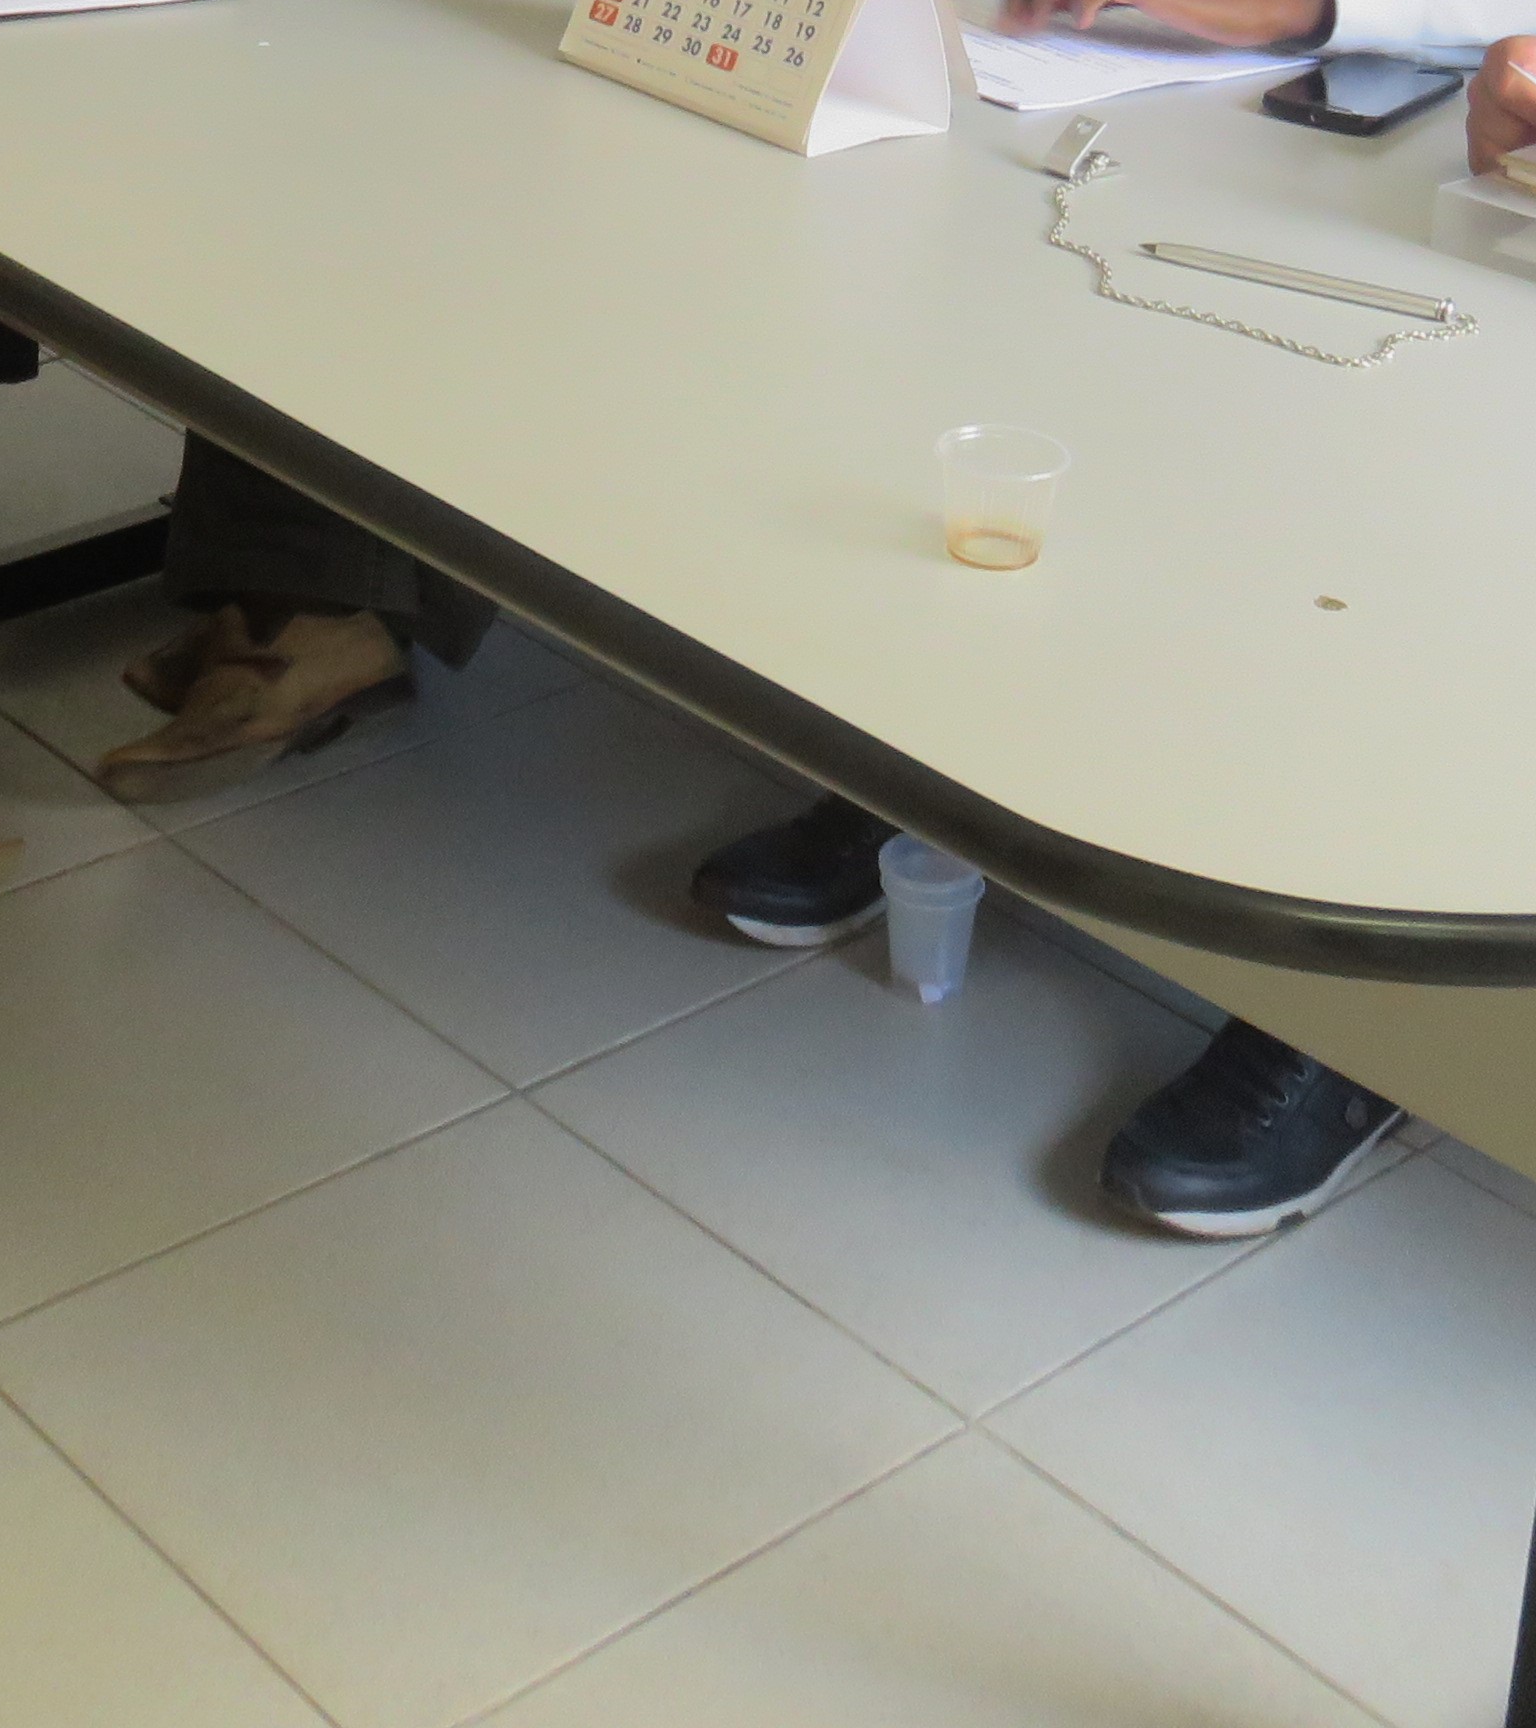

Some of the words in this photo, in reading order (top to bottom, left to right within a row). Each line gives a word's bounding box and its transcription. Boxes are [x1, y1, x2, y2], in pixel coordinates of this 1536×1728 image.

[594, 3, 616, 20] 27
[623, 14, 642, 33] 28
[652, 25, 673, 44] 29
[681, 37, 702, 56] 30
[712, 47, 732, 68] 31
[661, 1, 681, 21] 22
[691, 13, 711, 32] 23
[722, 23, 741, 43] 24
[752, 35, 773, 54] 25
[783, 47, 804, 67] 26
[733, 0, 752, 17] 17
[764, 11, 783, 30] 18
[796, 21, 815, 41] 19
